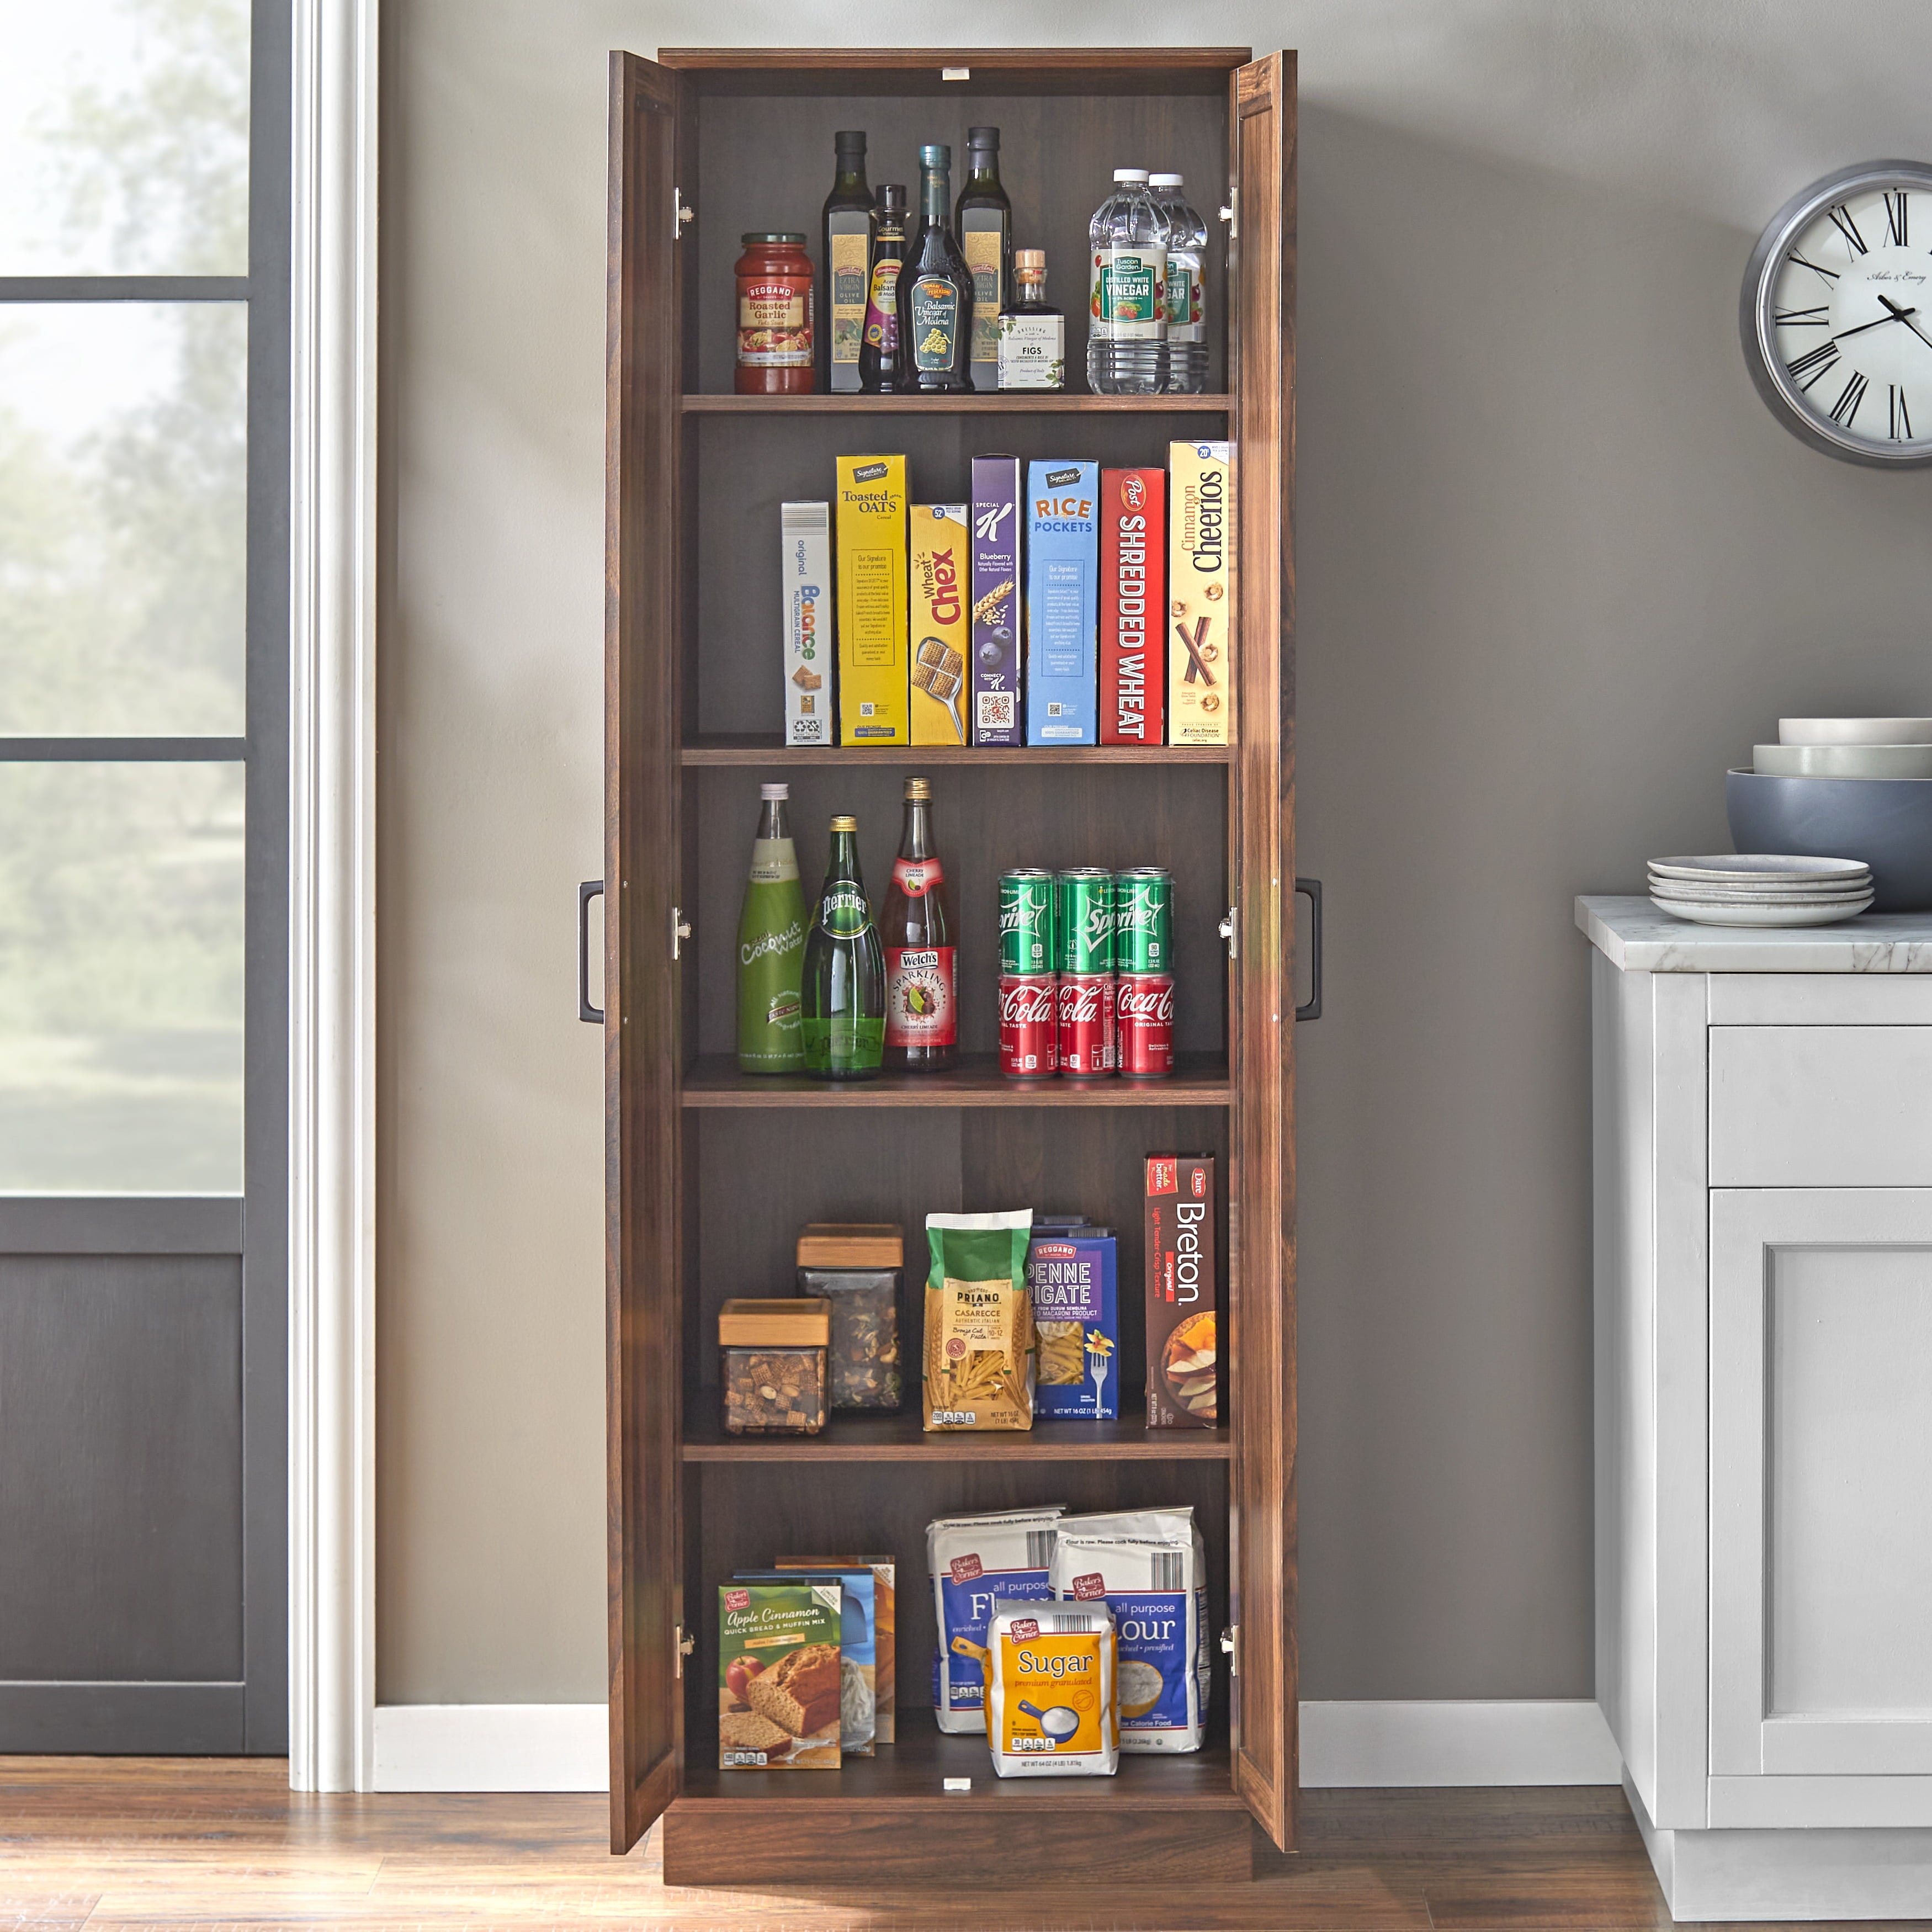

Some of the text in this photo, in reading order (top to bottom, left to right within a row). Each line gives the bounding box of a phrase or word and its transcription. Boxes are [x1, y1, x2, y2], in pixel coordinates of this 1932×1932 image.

[1882, 192, 1909, 248] XII
[1788, 247, 1841, 291] X
[750, 286, 791, 296] REGGANO
[1106, 284, 1149, 296] VINEGAR
[749, 302, 790, 310] Roasted
[915, 306, 943, 319] Vinegar
[925, 301, 955, 310] Balsamic
[755, 310, 787, 319] Garlic
[916, 315, 949, 326] Modena
[857, 467, 882, 478] Signature
[1050, 473, 1075, 484] Signature
[842, 490, 888, 501] Toasted
[1126, 480, 1143, 507] Post
[859, 501, 896, 513] OATS
[1036, 498, 1092, 519] RICE
[976, 502, 1013, 542] K
[1181, 485, 1200, 551] Cinnamon
[1192, 471, 1222, 572] Cheerios
[1034, 522, 1092, 532] POCKETS
[796, 540, 807, 575] original
[867, 555, 887, 563] Signature
[921, 559, 935, 599] Wheat
[931, 548, 962, 625] Chex
[1119, 515, 1146, 648] SHREDDED
[801, 585, 821, 660] Balance
[991, 675, 1005, 691] K
[1118, 653, 1145, 739] WHEAT
[741, 921, 801, 965] Coconut
[774, 934, 803, 955] Water
[903, 953, 937, 967] Welch's
[893, 969, 946, 992] SPARKLING
[1155, 1163, 1164, 1191] better
[1194, 1173, 1203, 1193] Dare
[1152, 1207, 1161, 1224] Light
[1153, 1226, 1161, 1270] Tender-Crisp
[1177, 1203, 1206, 1303] Breton
[1164, 1262, 1173, 1292] original
[957, 1292, 999, 1302] PRIANO
[953, 1327, 971, 1336] Bronze
[953, 1569, 981, 1583] Corner
[994, 1581, 1005, 1591] all
[1075, 1588, 1103, 1601] Corner
[727, 1607, 820, 1628] Apple Cinnamon
[1116, 1603, 1175, 1616] all purpose
[952, 1624, 982, 1633] enriched
[1012, 1630, 1038, 1643] Corner
[1019, 1650, 1094, 1678] Sugar
[1050, 1678, 1092, 1689] granulated
